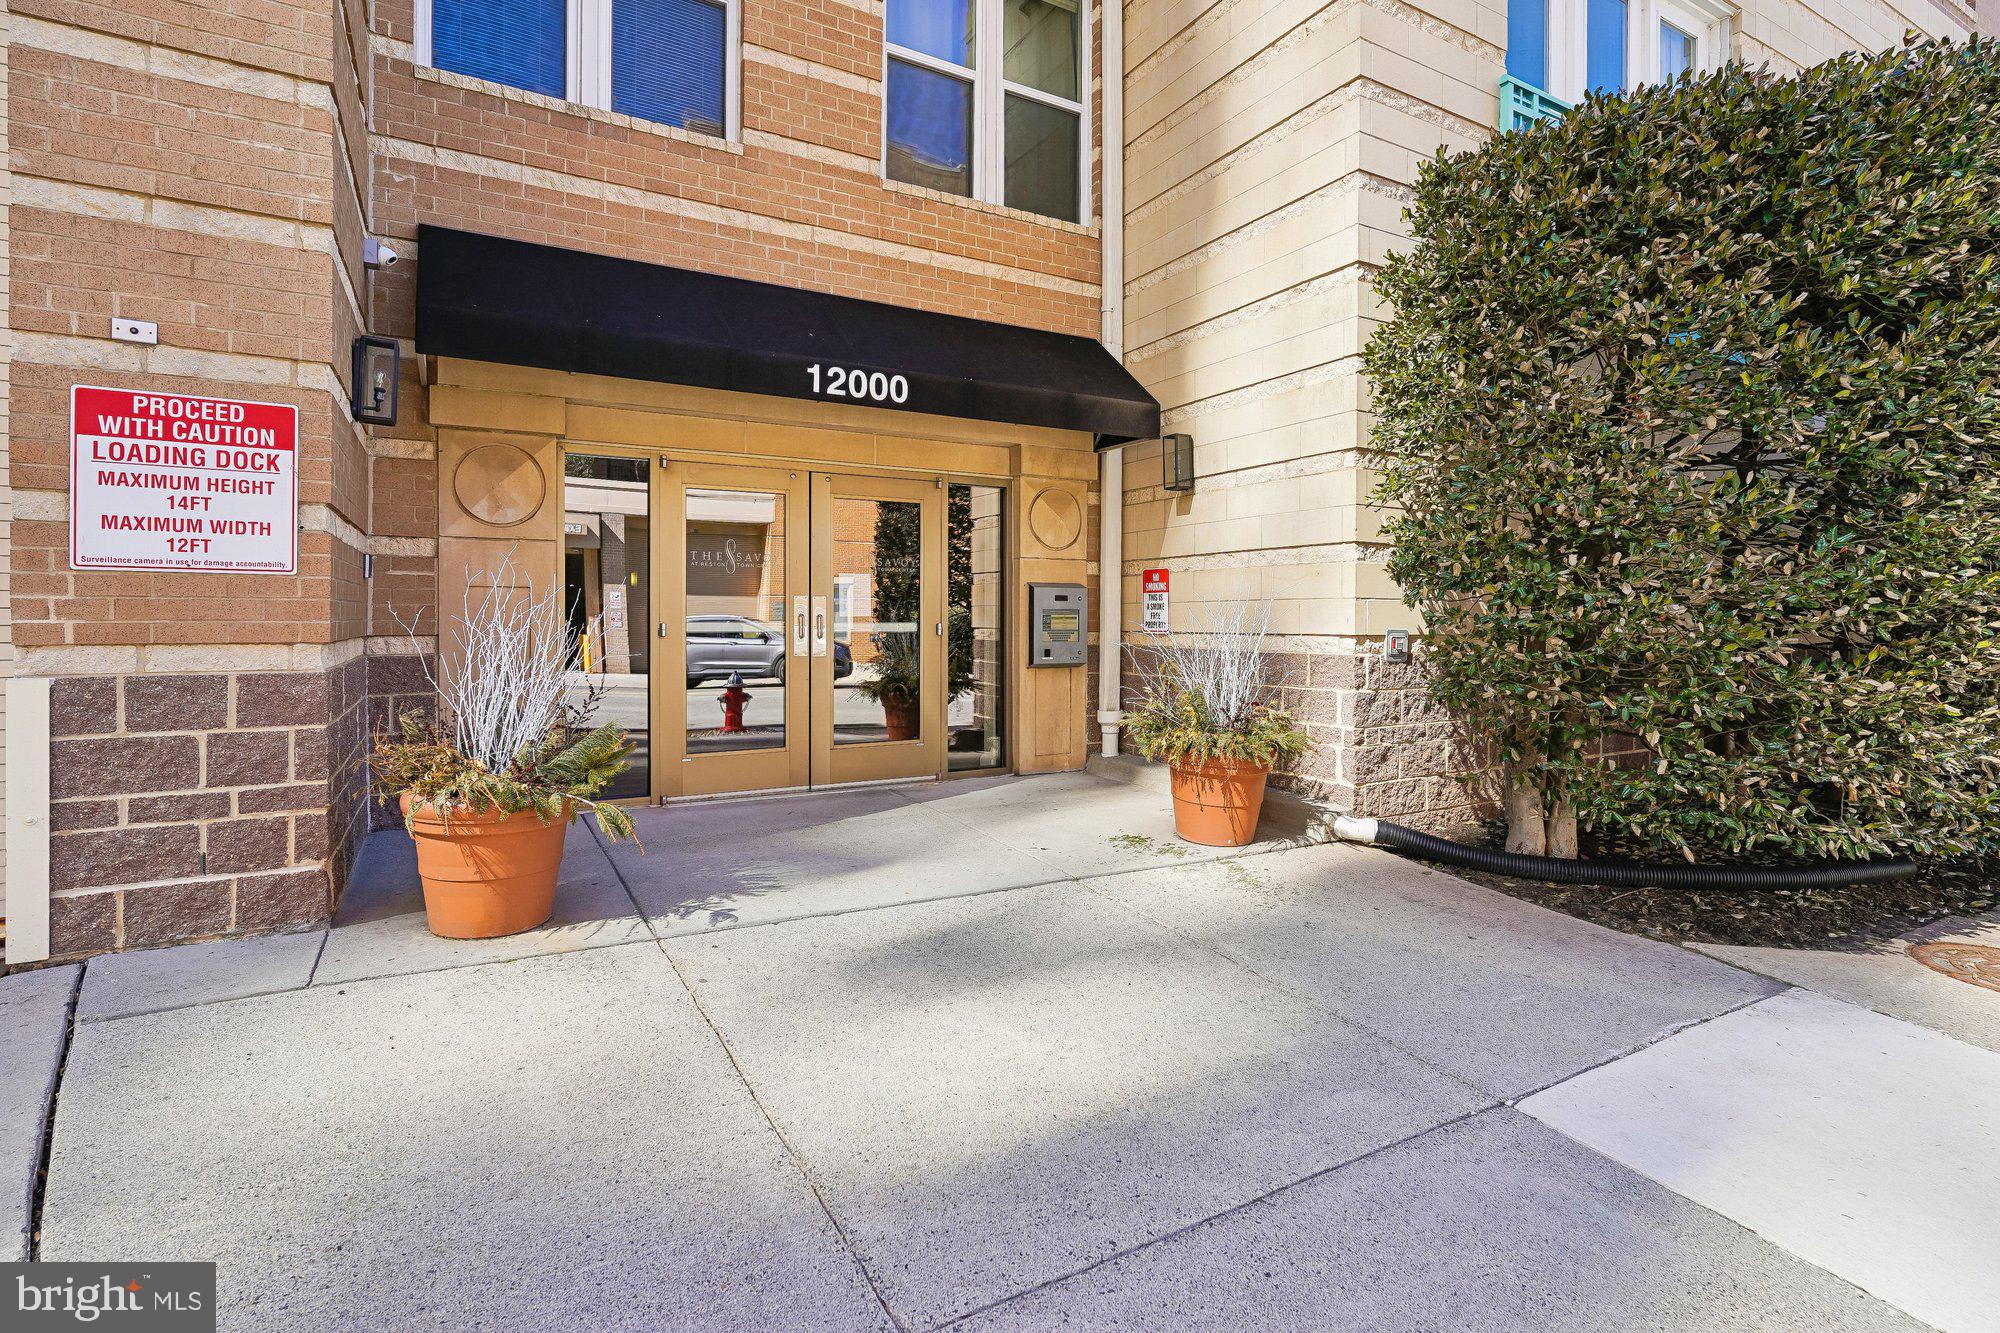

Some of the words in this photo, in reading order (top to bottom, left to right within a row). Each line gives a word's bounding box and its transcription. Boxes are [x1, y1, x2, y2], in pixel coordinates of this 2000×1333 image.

[807, 364, 908, 403] 12000
[133, 395, 244, 423] PROCEED
[98, 414, 163, 438] WITH
[172, 422, 275, 446] CAUTION
[92, 440, 206, 467] LOADING
[216, 450, 280, 472] DOCK
[98, 471, 200, 491] MAXIMUM
[207, 477, 275, 495] HEIGHT
[166, 495, 212, 511] 14FT
[101, 514, 203, 533] MAXIMUM
[210, 519, 271, 536] WIDTH
[166, 538, 212, 553] 12FT
[81, 555, 132, 564] Surveillance
[204, 559, 233, 568] damage
[690, 550, 723, 561] THE
[1145, 582, 1167, 591] SMOKING
[1152, 573, 1160, 581] NO
